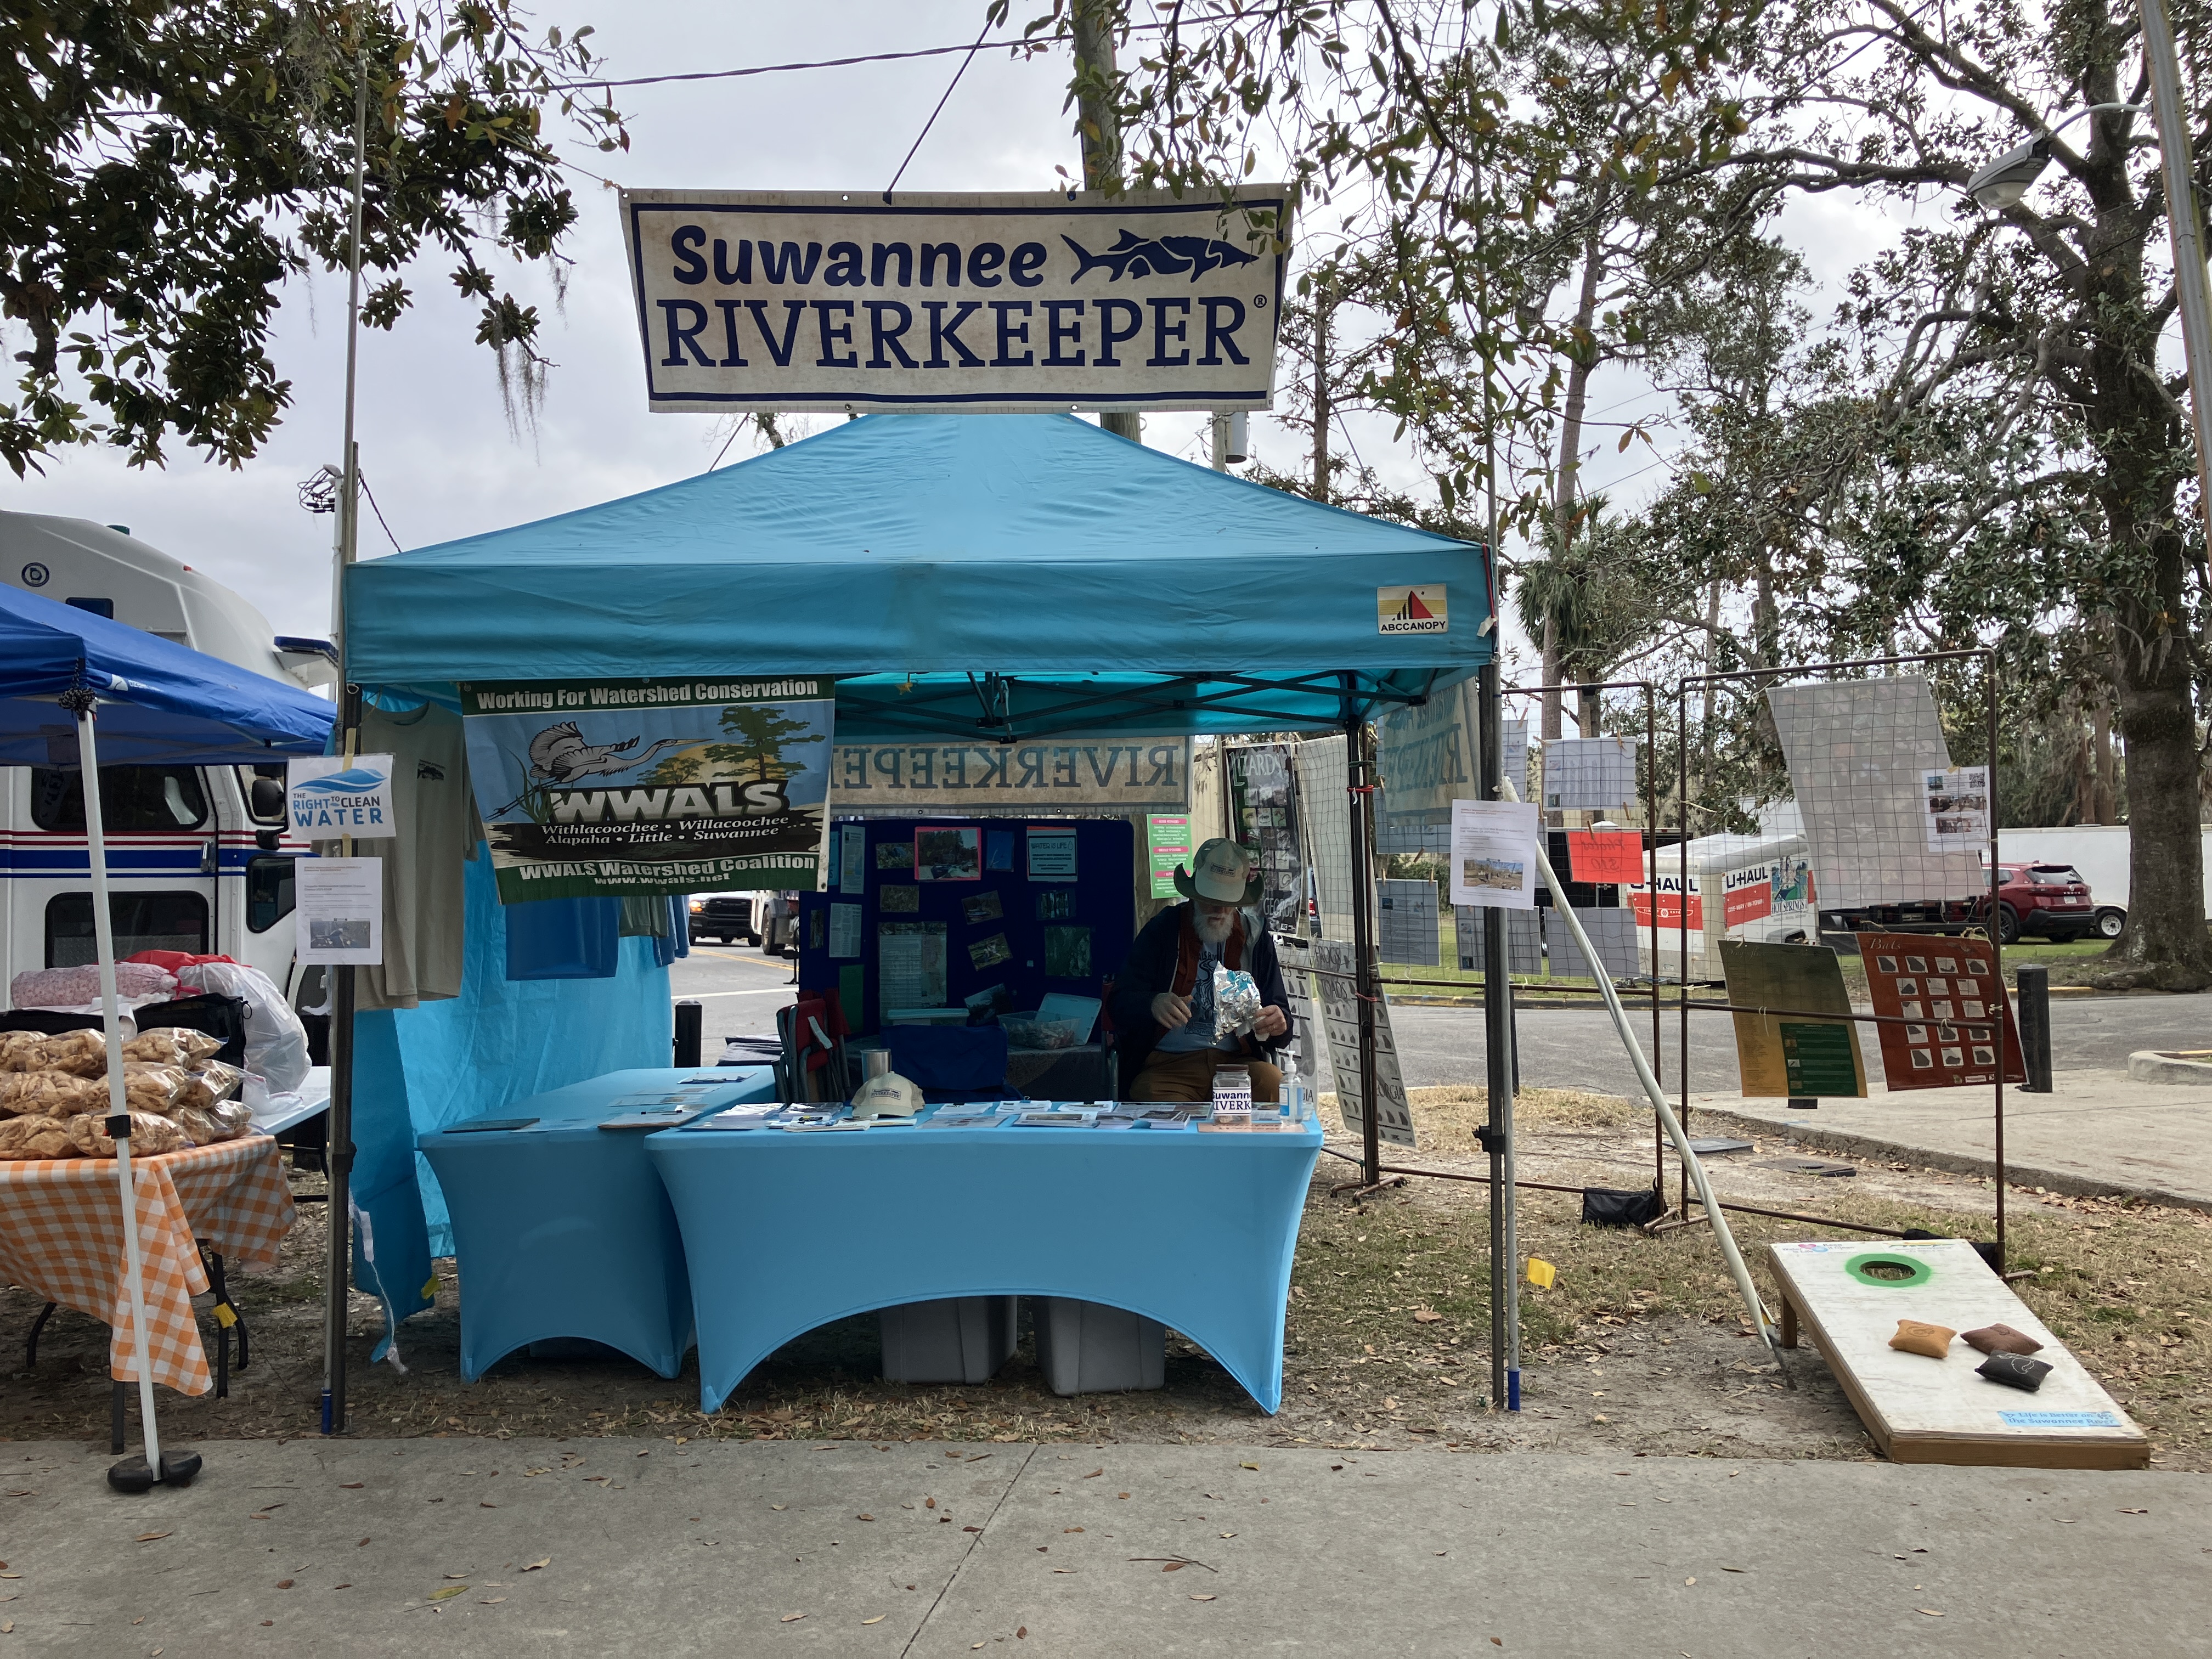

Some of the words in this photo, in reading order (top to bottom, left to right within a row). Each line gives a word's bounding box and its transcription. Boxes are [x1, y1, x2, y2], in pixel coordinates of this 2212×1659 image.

[670, 224, 1048, 287] Suwannee
[1381, 621, 1446, 631] ABCCANOPY
[476, 690, 554, 709] Working
[557, 689, 586, 706] For
[589, 684, 691, 705] Watershed
[695, 679, 818, 701] Conservation
[1228, 752, 1286, 786] LIZARDS
[292, 799, 330, 810] RIGHT
[341, 796, 380, 808] CLEAN
[549, 783, 782, 822] WWALS
[294, 808, 383, 827] WATER
[541, 822, 659, 835] Withlacoochee
[679, 816, 789, 830] Willacoochee
[544, 834, 610, 846] Alapaha
[628, 832, 673, 844] Little
[693, 826, 779, 840] Suwannee
[519, 862, 597, 881] WWALS
[599, 861, 715, 877] Watershed
[720, 855, 815, 872] Coalition
[594, 872, 730, 884] www.wwals.net
[1726, 866, 1768, 889] U-HAUL
[1870, 938, 1901, 950] Bats
[1314, 945, 1341, 967] FROGS
[1321, 978, 1347, 1000] TOADS
